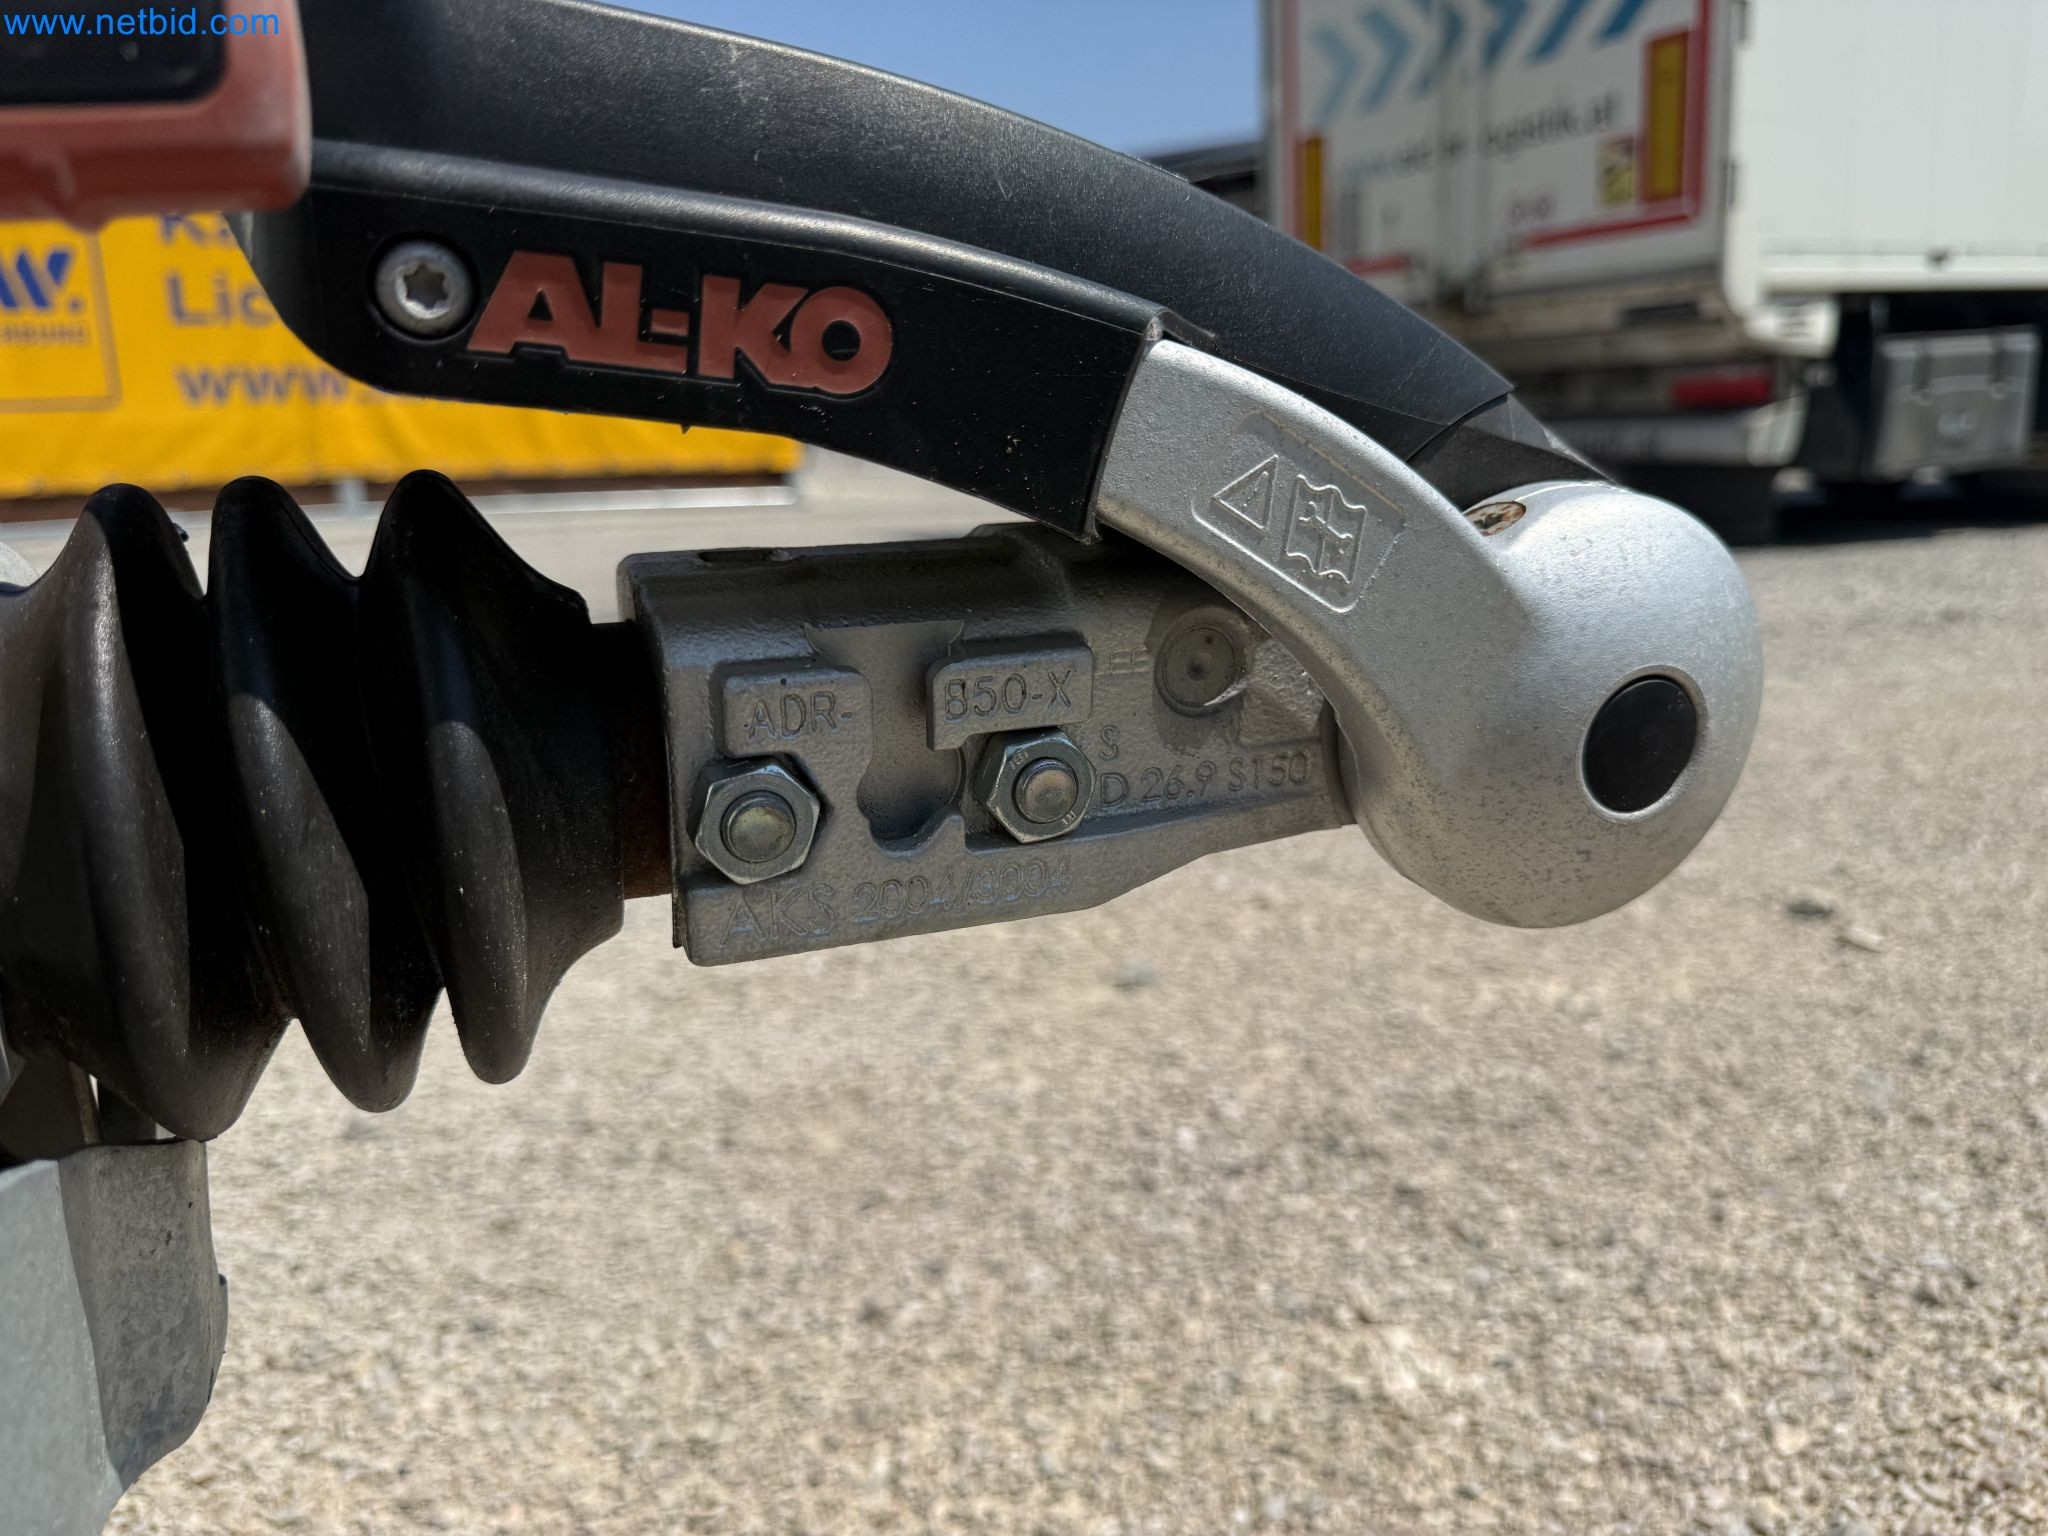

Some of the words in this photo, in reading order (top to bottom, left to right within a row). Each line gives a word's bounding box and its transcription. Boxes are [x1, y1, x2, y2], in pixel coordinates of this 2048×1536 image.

[467, 250, 892, 395] AL-KO
[748, 690, 854, 741] ADR-
[719, 882, 838, 946] AKS
